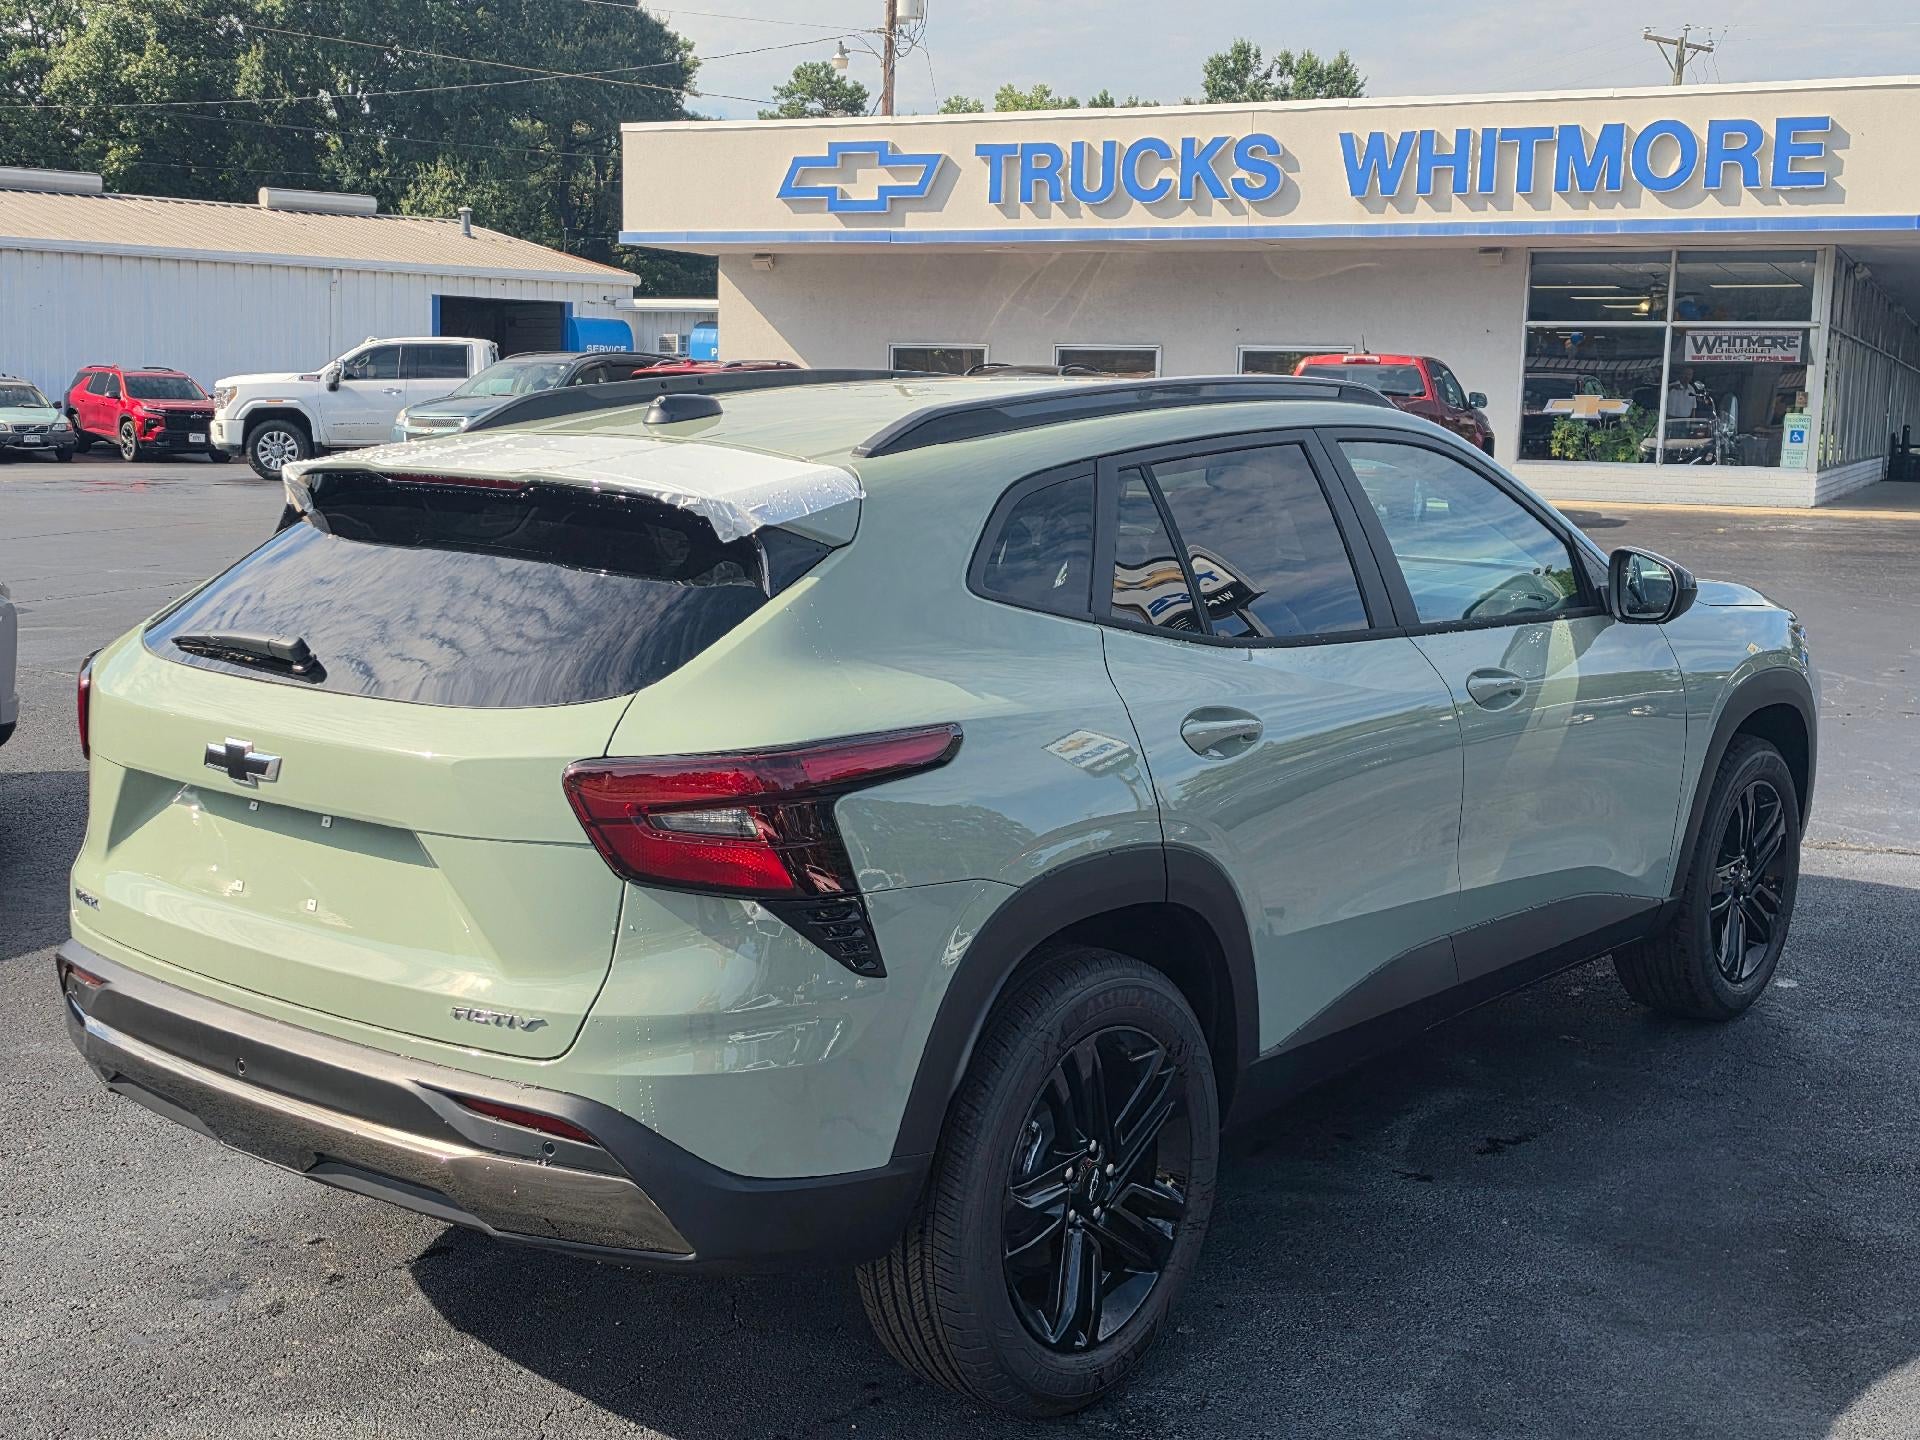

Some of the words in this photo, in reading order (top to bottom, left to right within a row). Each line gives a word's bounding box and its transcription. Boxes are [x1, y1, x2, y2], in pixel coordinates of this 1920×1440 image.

[975, 132, 1284, 206] TRUCKS
[1339, 115, 1832, 198] WHITMORE
[586, 344, 627, 353] SERVICE
[1690, 335, 1799, 354] WHITMORE
